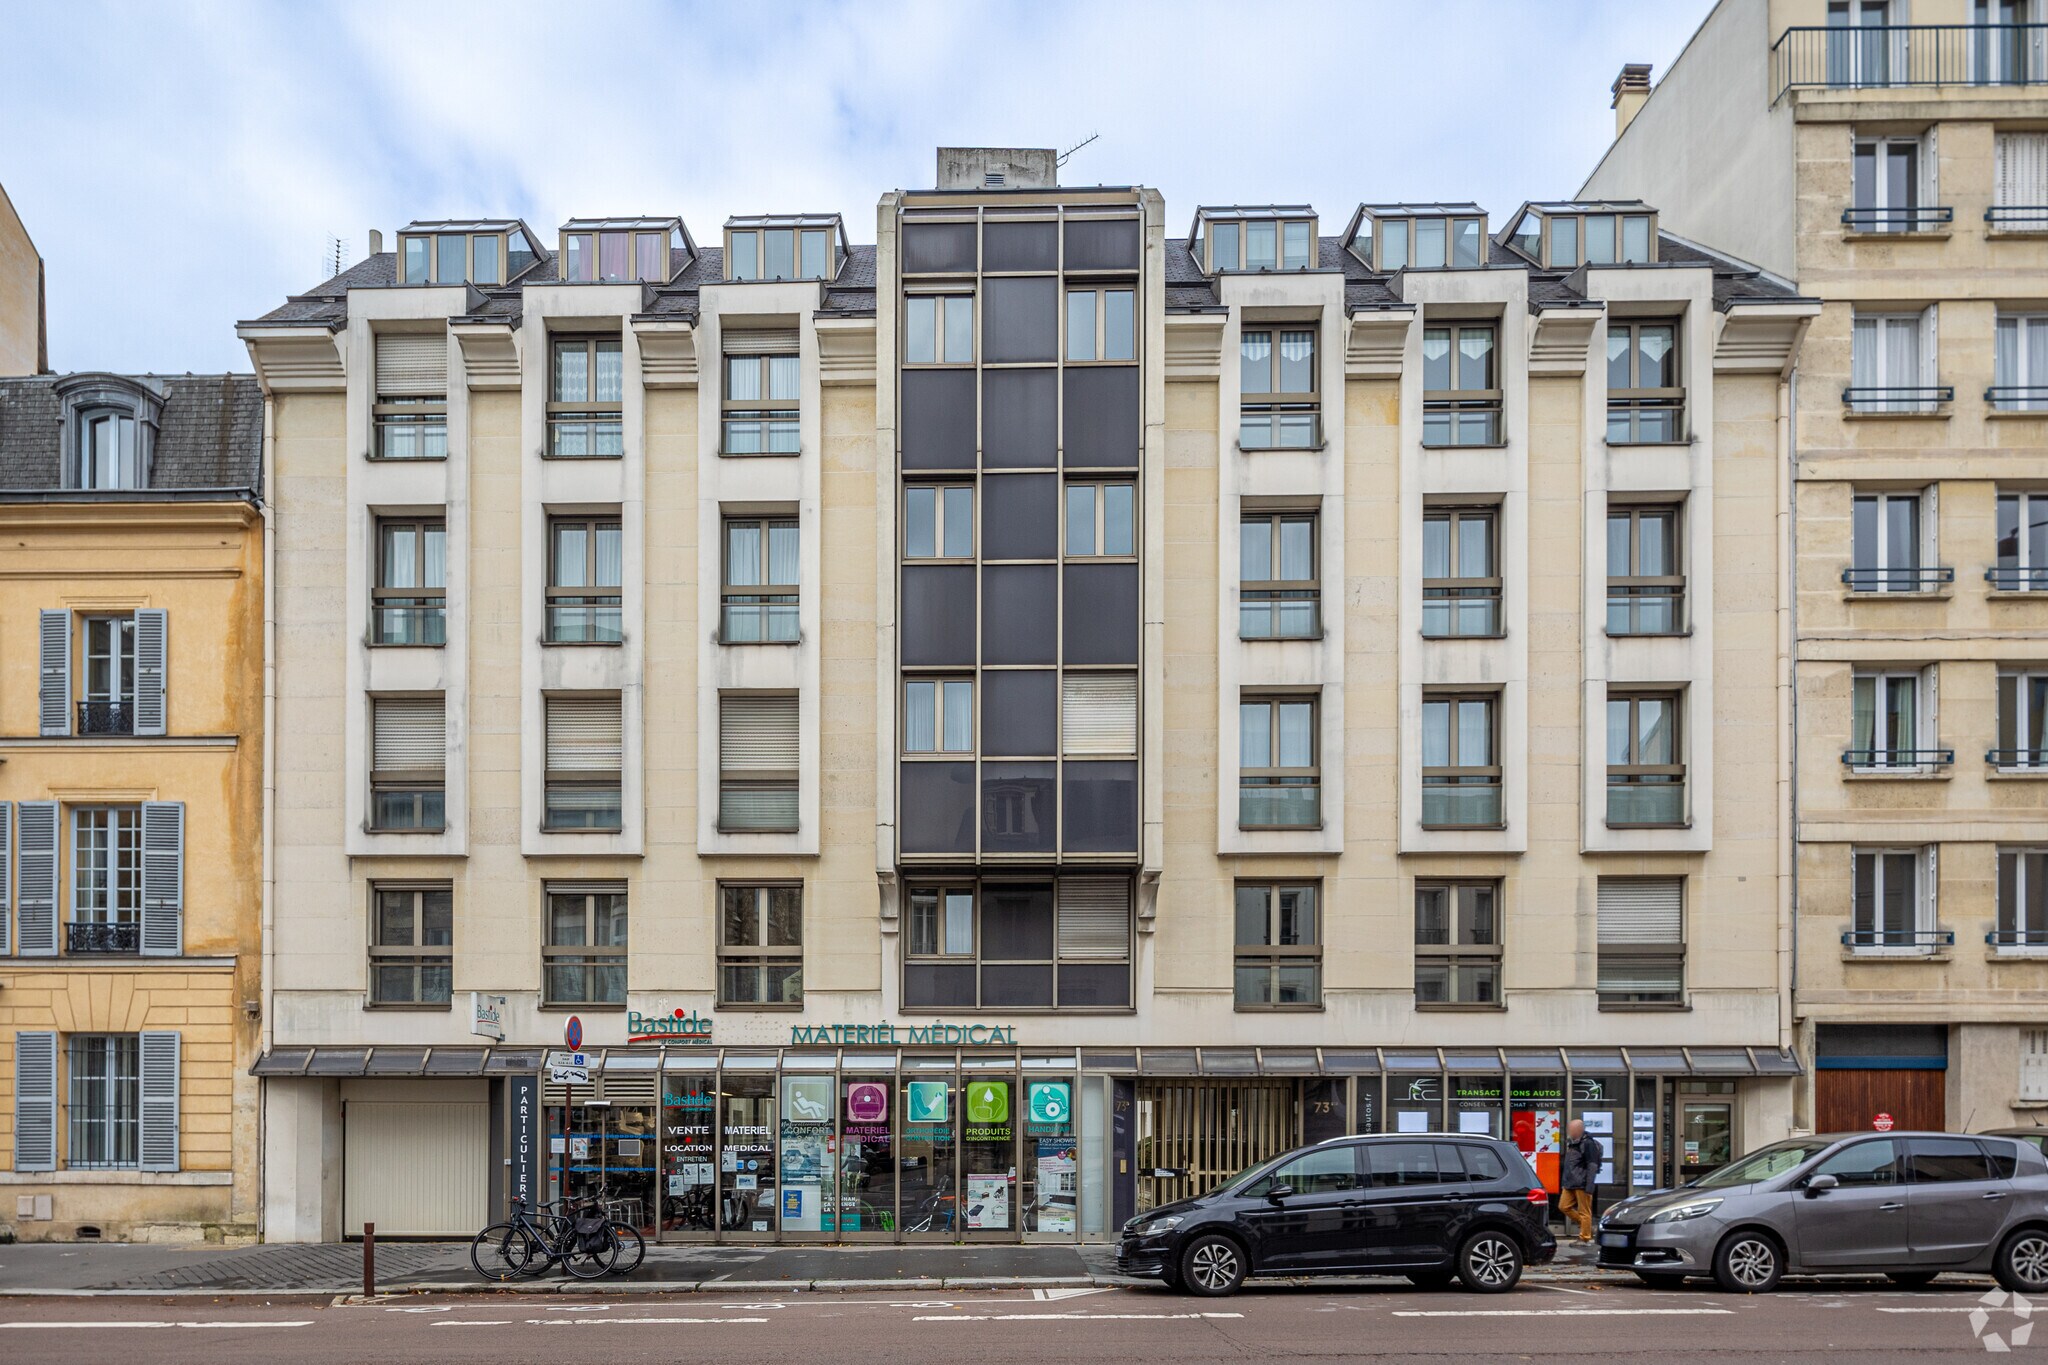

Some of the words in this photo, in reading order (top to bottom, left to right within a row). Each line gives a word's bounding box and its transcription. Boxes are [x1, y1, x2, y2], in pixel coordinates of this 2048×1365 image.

[477, 1004, 500, 1022] Bastide
[628, 1008, 713, 1034] Bastide
[664, 1090, 712, 1106] Bastide
[1314, 1101, 1330, 1113] 73
[668, 1126, 710, 1135] VENTE
[724, 1126, 772, 1135] MATERIEL
[787, 1126, 830, 1134] CONFORT
[846, 1126, 890, 1134] MATERIEL
[966, 1128, 1011, 1136] PRODUITS
[520, 1086, 529, 1200] PARTICULIERS
